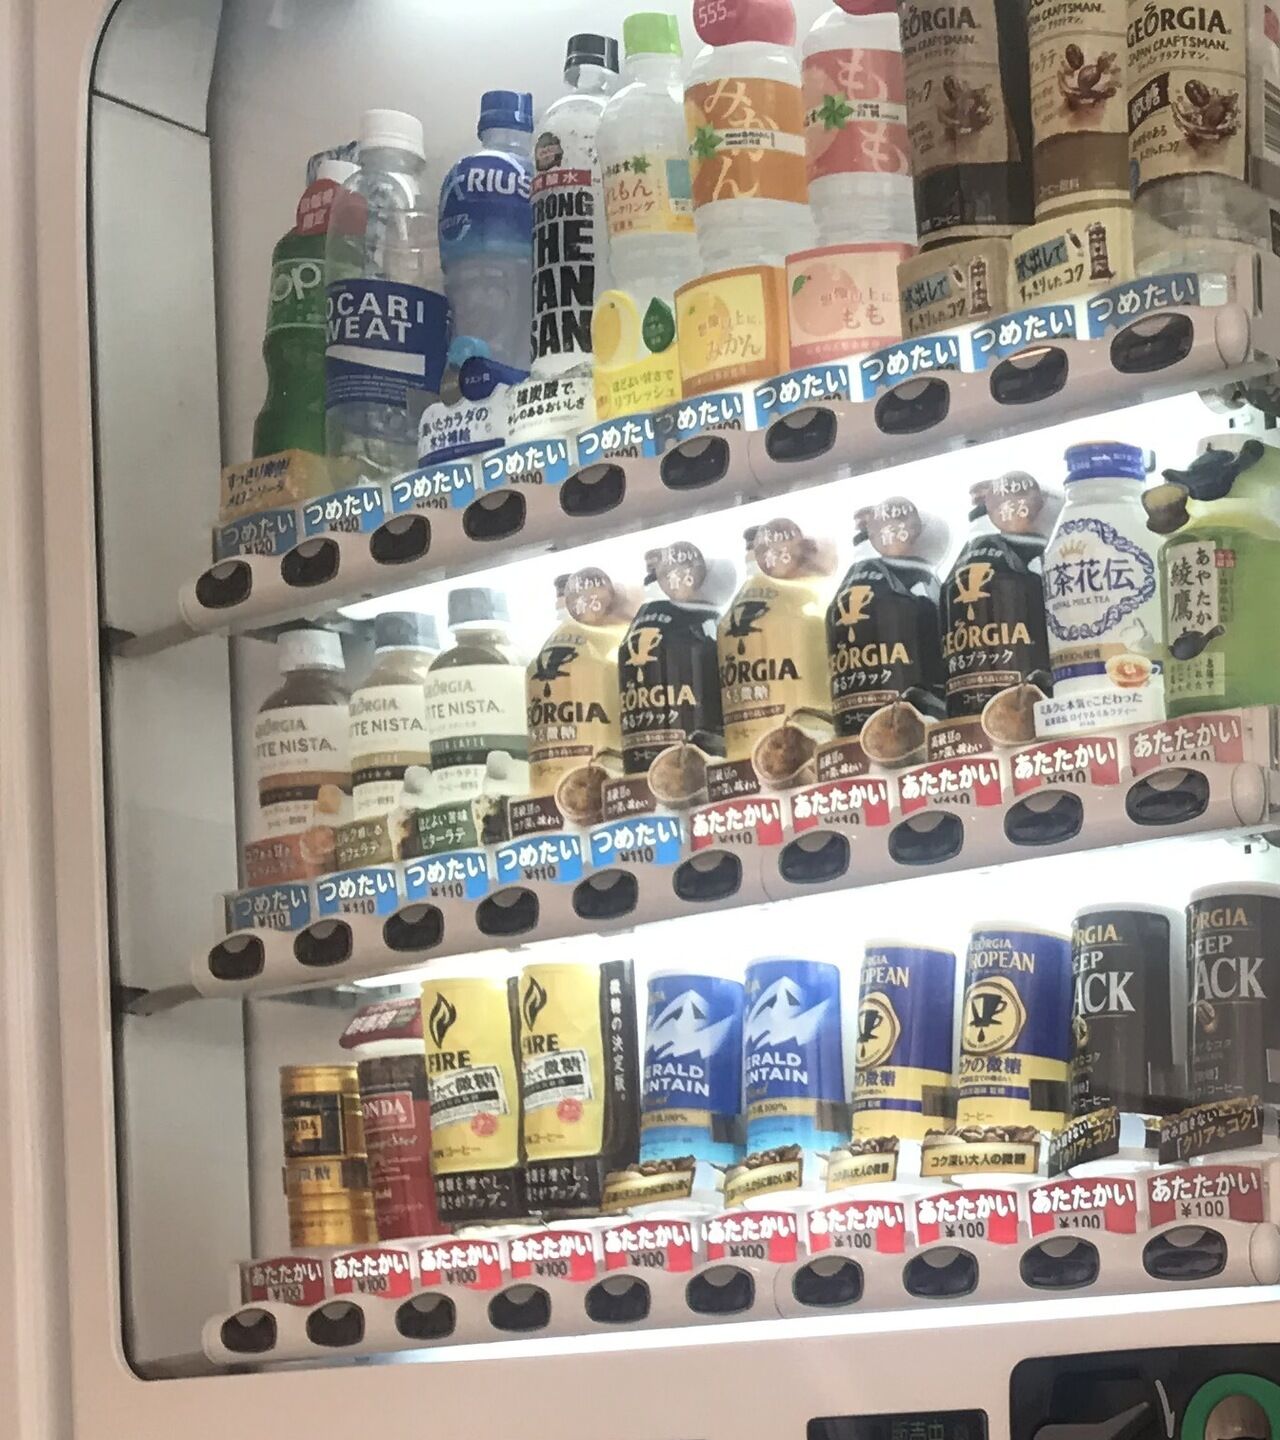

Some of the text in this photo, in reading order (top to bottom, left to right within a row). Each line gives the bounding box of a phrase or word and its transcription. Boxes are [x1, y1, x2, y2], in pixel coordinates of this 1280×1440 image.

[1126, 2, 1229, 49] GEORGIA
[1090, 277, 1197, 322] つめたい
[972, 310, 1074, 353] つめたい
[862, 340, 959, 381] つめたい
[756, 367, 848, 409] つめたい
[656, 396, 742, 434] つめたい
[485, 442, 566, 480] つめたい
[393, 466, 471, 502] つめたい
[992, 477, 1034, 496] 味わい
[306, 490, 381, 525] つめたい
[875, 502, 914, 521] 味わい
[223, 513, 294, 545] つめたい
[761, 526, 798, 544] 味わい
[661, 548, 698, 565] 味わい
[568, 577, 606, 593] 味わい
[1169, 559, 1194, 624] 綾鷹
[1194, 546, 1215, 627] あやたか
[948, 649, 1014, 675] 香るブラック
[1133, 720, 1240, 758] あたたかい
[1014, 738, 1116, 780] あたたかい
[901, 761, 998, 800] あたたかい
[794, 783, 887, 819] あたたかい
[693, 801, 780, 838] あたたかい
[592, 820, 679, 854] つめたい
[498, 838, 579, 871] つめたい
[621, 846, 654, 864] ¥110
[407, 854, 486, 886] つめたい
[525, 865, 556, 882] ¥110
[319, 870, 395, 901] つめたい
[430, 883, 463, 898] ¥110
[241, 888, 307, 916] つめたい
[428, 1050, 472, 1074] FIRE
[930, 1152, 1027, 1169] コク深い大人の微糖
[1031, 1179, 1134, 1214] あたたかい
[1151, 1171, 1258, 1202] あたたかい
[810, 1202, 902, 1233] あたたかい
[918, 1192, 1016, 1224] あたたかい
[1059, 1213, 1101, 1229] ¥100
[1180, 1201, 1225, 1218] ¥100
[605, 1223, 689, 1253] あたたかい
[706, 1214, 796, 1244] あたたかい
[834, 1232, 871, 1249] ¥100
[945, 1221, 985, 1239] ¥100
[420, 1242, 499, 1271] あたたかい
[512, 1233, 592, 1262] あたたかい
[631, 1252, 664, 1268] ¥100
[730, 1244, 765, 1260] ¥100
[251, 1262, 322, 1288] あたたかい
[334, 1254, 410, 1280] あたたかい
[447, 1268, 476, 1284] ¥100
[536, 1260, 568, 1276] ¥100
[272, 1285, 301, 1301] ¥100
[358, 1277, 387, 1292] ¥100
